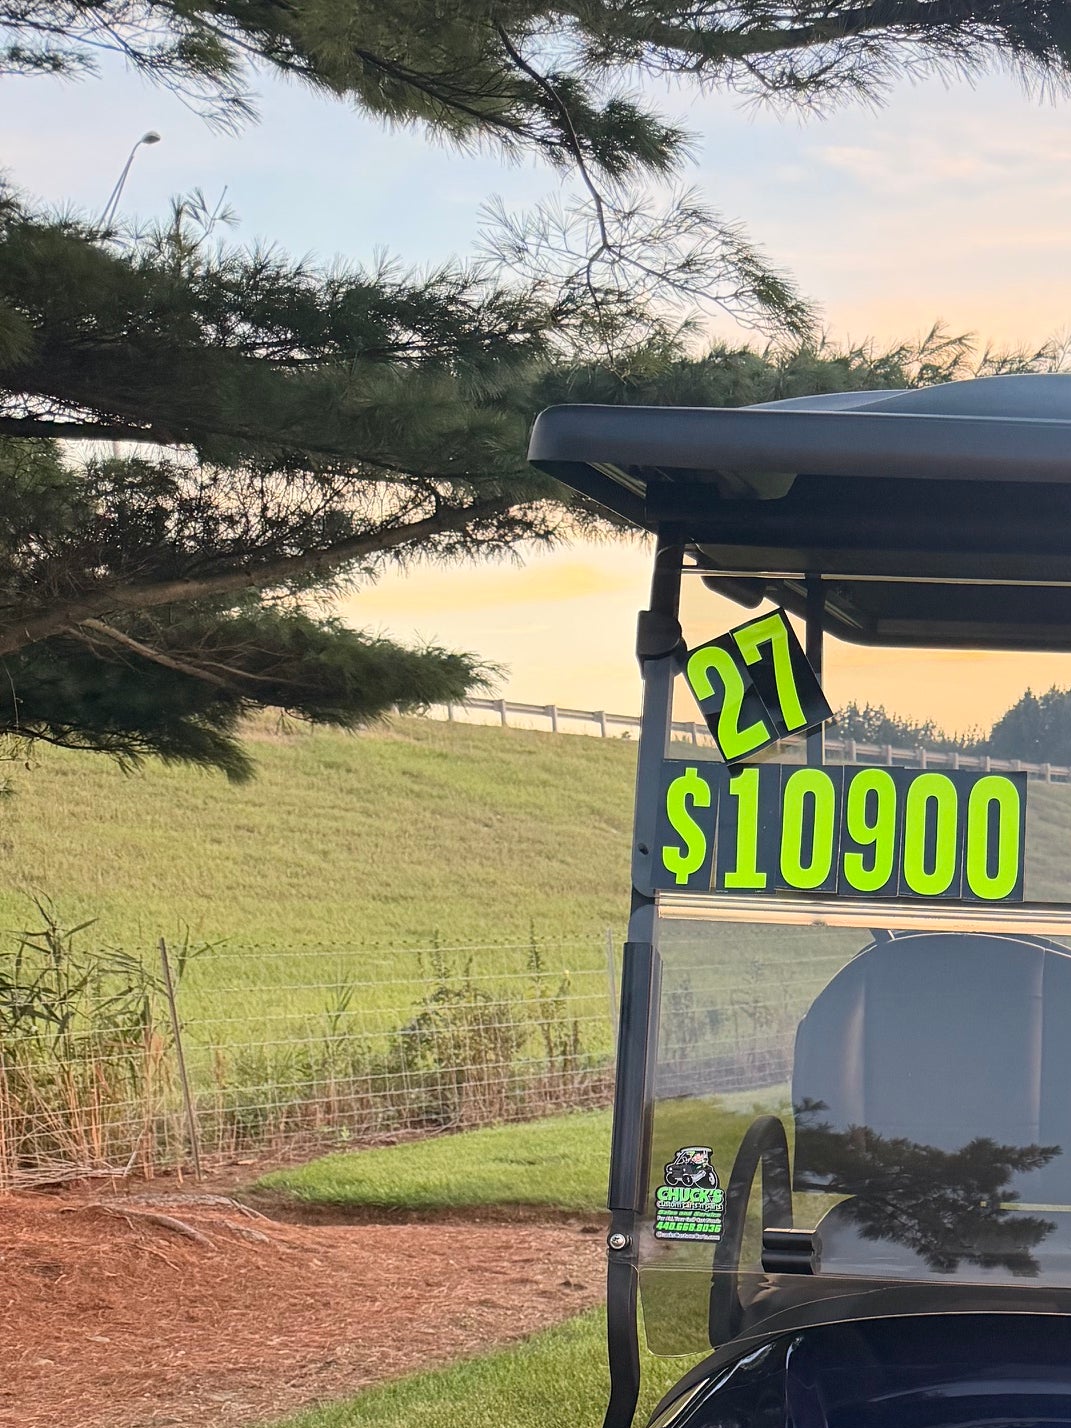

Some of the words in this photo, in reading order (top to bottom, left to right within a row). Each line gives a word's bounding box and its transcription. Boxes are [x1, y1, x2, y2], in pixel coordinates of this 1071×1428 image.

[686, 613, 807, 761] 27
[662, 767, 1020, 900] $10900
[657, 1186, 724, 1204] CHUCK'S
